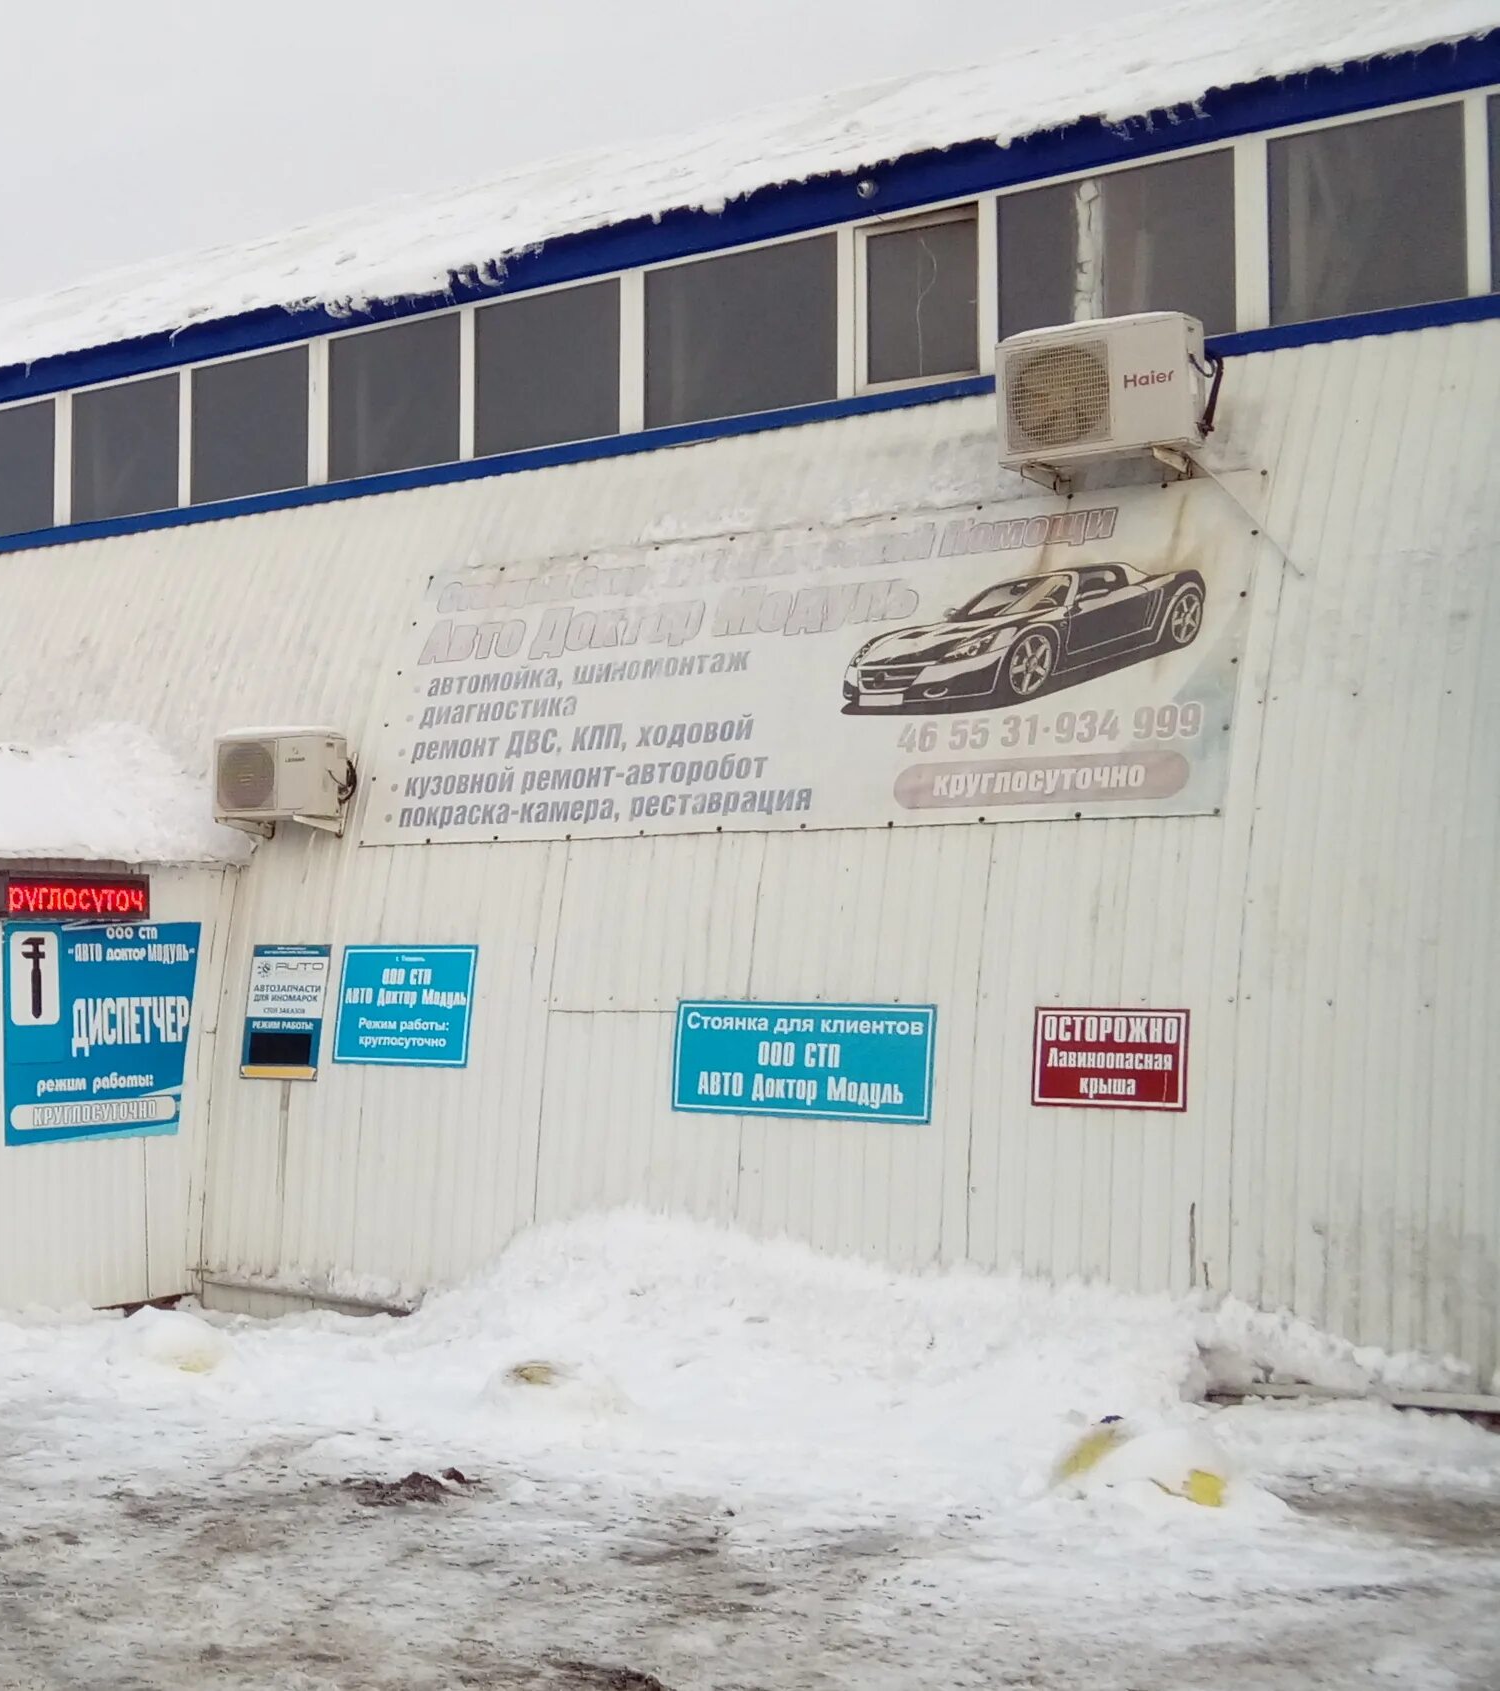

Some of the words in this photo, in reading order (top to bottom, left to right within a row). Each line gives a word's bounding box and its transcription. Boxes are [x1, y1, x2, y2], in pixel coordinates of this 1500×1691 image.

[1124, 369, 1175, 389] Haier
[427, 665, 564, 697] автомойка,
[572, 650, 752, 685] шиномонтаж
[419, 694, 578, 729] диагностика
[410, 735, 500, 763] ремонт
[571, 723, 627, 752] КПП,
[636, 714, 755, 747] ходовой
[897, 721, 938, 753] 46
[948, 718, 990, 750] 55
[1133, 702, 1202, 741] 999
[404, 767, 514, 798] кузовной
[521, 754, 769, 794] ремонт-авторобот
[933, 764, 1146, 798] круглосуточно
[399, 797, 621, 829] покраска-камера,
[629, 787, 813, 822] реставрация
[106, 926, 134, 940] ООО
[253, 984, 321, 993] АВТОЗАПЧАСТИ
[382, 968, 405, 985] ООО
[253, 994, 269, 1002] ДЛЯ
[271, 994, 318, 1002] ИНОМАРОК
[345, 987, 373, 1004] АВТО
[377, 988, 417, 1008] Доктор
[421, 988, 467, 1009] Модуль
[71, 995, 190, 1058] ДИСПЕТЧЕР
[252, 1021, 280, 1030] РЕЖИМ
[358, 1017, 397, 1030] Режим
[400, 1018, 450, 1032] работы:
[686, 1011, 769, 1032] Стоянка
[773, 1017, 814, 1035] для
[820, 1019, 924, 1036] клиентов
[1044, 1016, 1178, 1044] ОСТОРОЖНО
[359, 1035, 447, 1049] круглосуточно
[757, 1041, 796, 1067] ООО
[804, 1042, 841, 1069] СТП
[1047, 1047, 1173, 1071] Лавиноопасная
[37, 1076, 87, 1097] режим
[93, 1071, 154, 1094] работы:
[697, 1071, 744, 1097] АВТО
[751, 1073, 818, 1106] Доктор
[827, 1076, 904, 1110] Модуль
[1079, 1077, 1136, 1099] крыша
[32, 1098, 157, 1127] КРУГЛОСУТОЧНО
